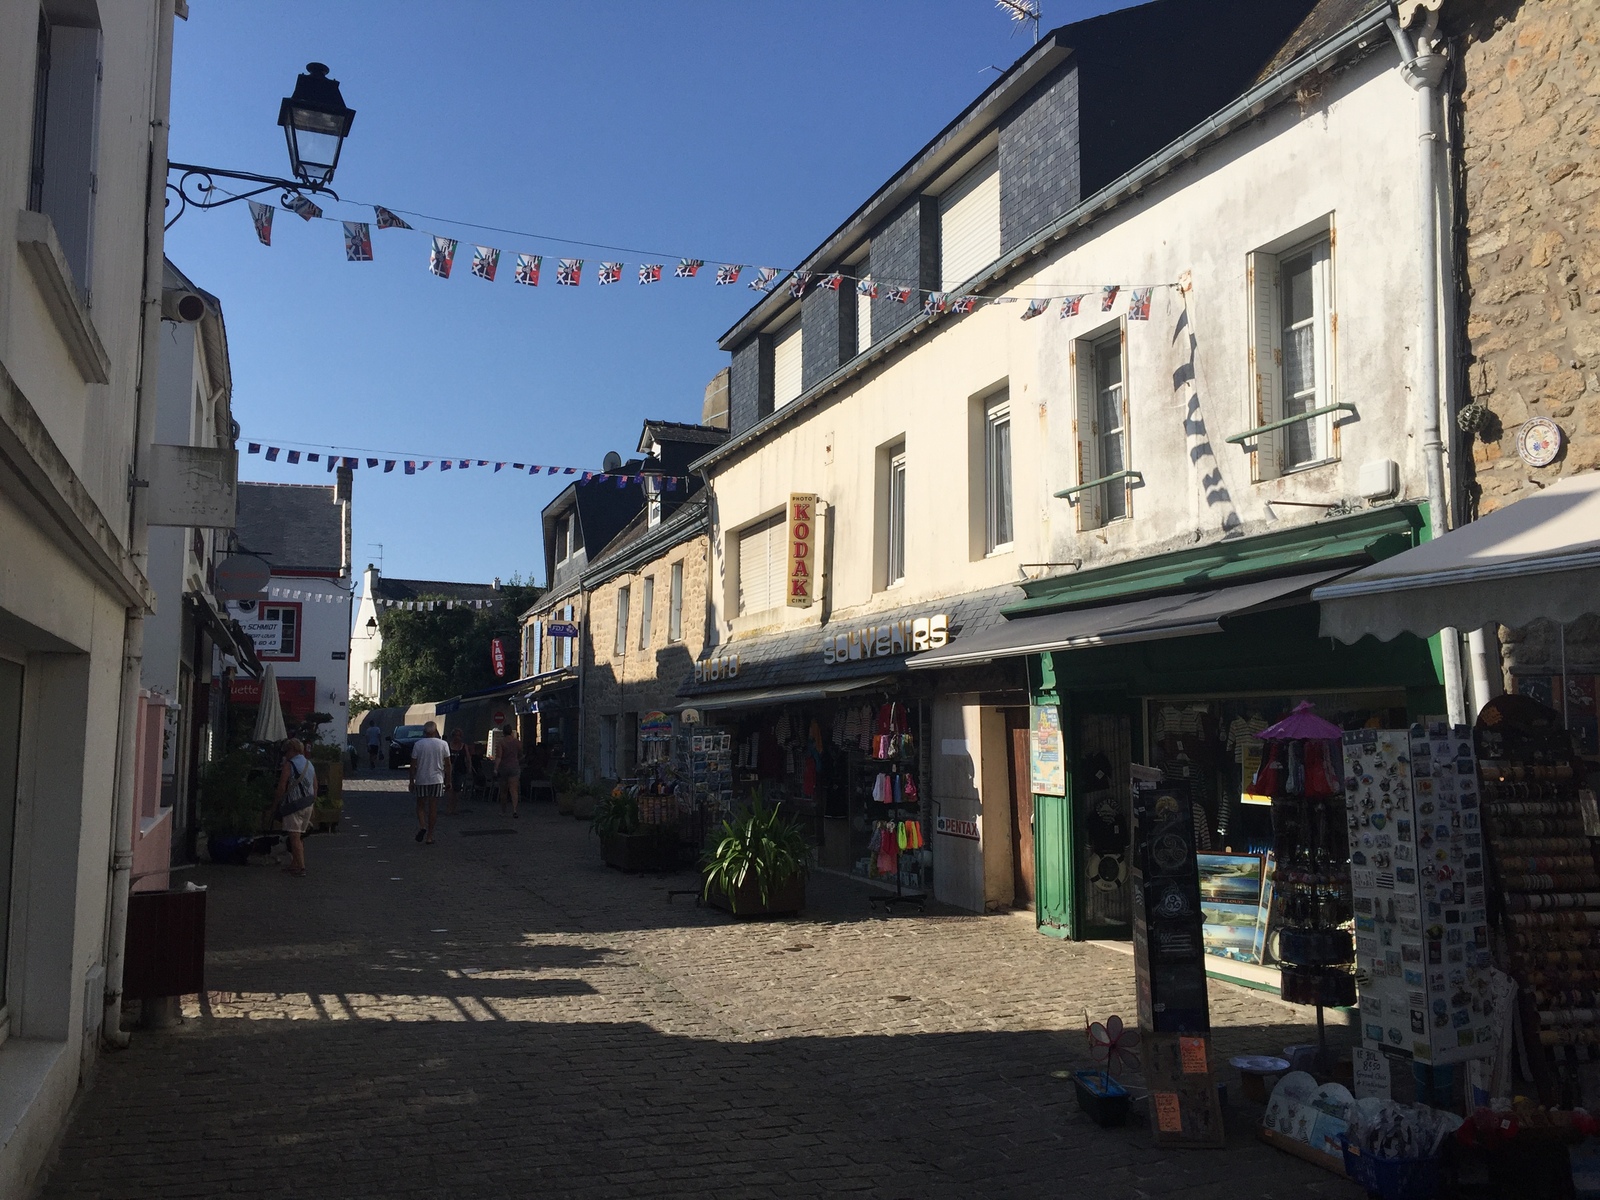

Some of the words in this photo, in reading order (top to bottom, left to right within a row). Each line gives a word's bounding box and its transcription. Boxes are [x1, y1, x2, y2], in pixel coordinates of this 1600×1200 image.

[791, 503, 810, 596] KODAK
[494, 640, 504, 675] TABAC
[694, 654, 741, 683] PHOTO
[230, 685, 259, 695] uette
[945, 819, 977, 836] PENTAX
